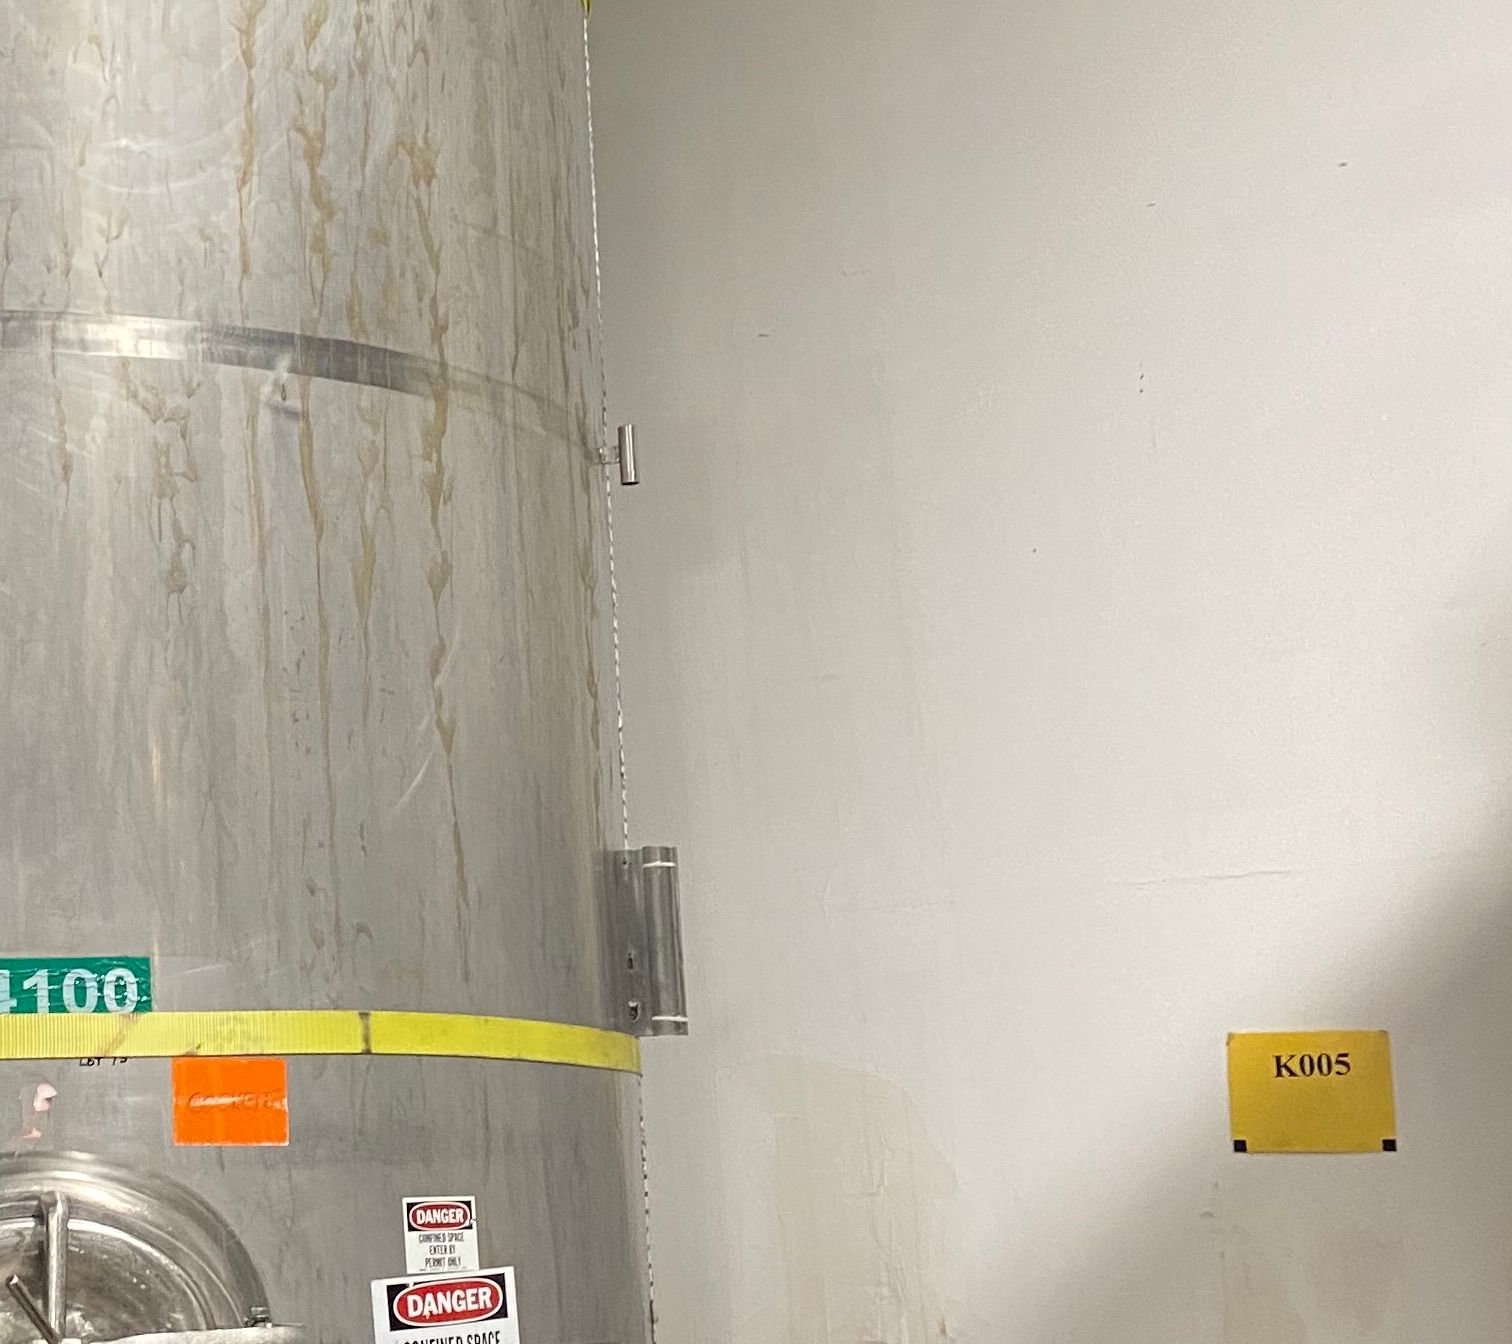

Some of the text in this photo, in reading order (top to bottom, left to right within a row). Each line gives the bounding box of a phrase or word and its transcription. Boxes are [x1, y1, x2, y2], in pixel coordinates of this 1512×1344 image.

[1273, 1052, 1351, 1078] K005
[416, 1208, 465, 1225] DANGER
[406, 1286, 493, 1318] DANGER
